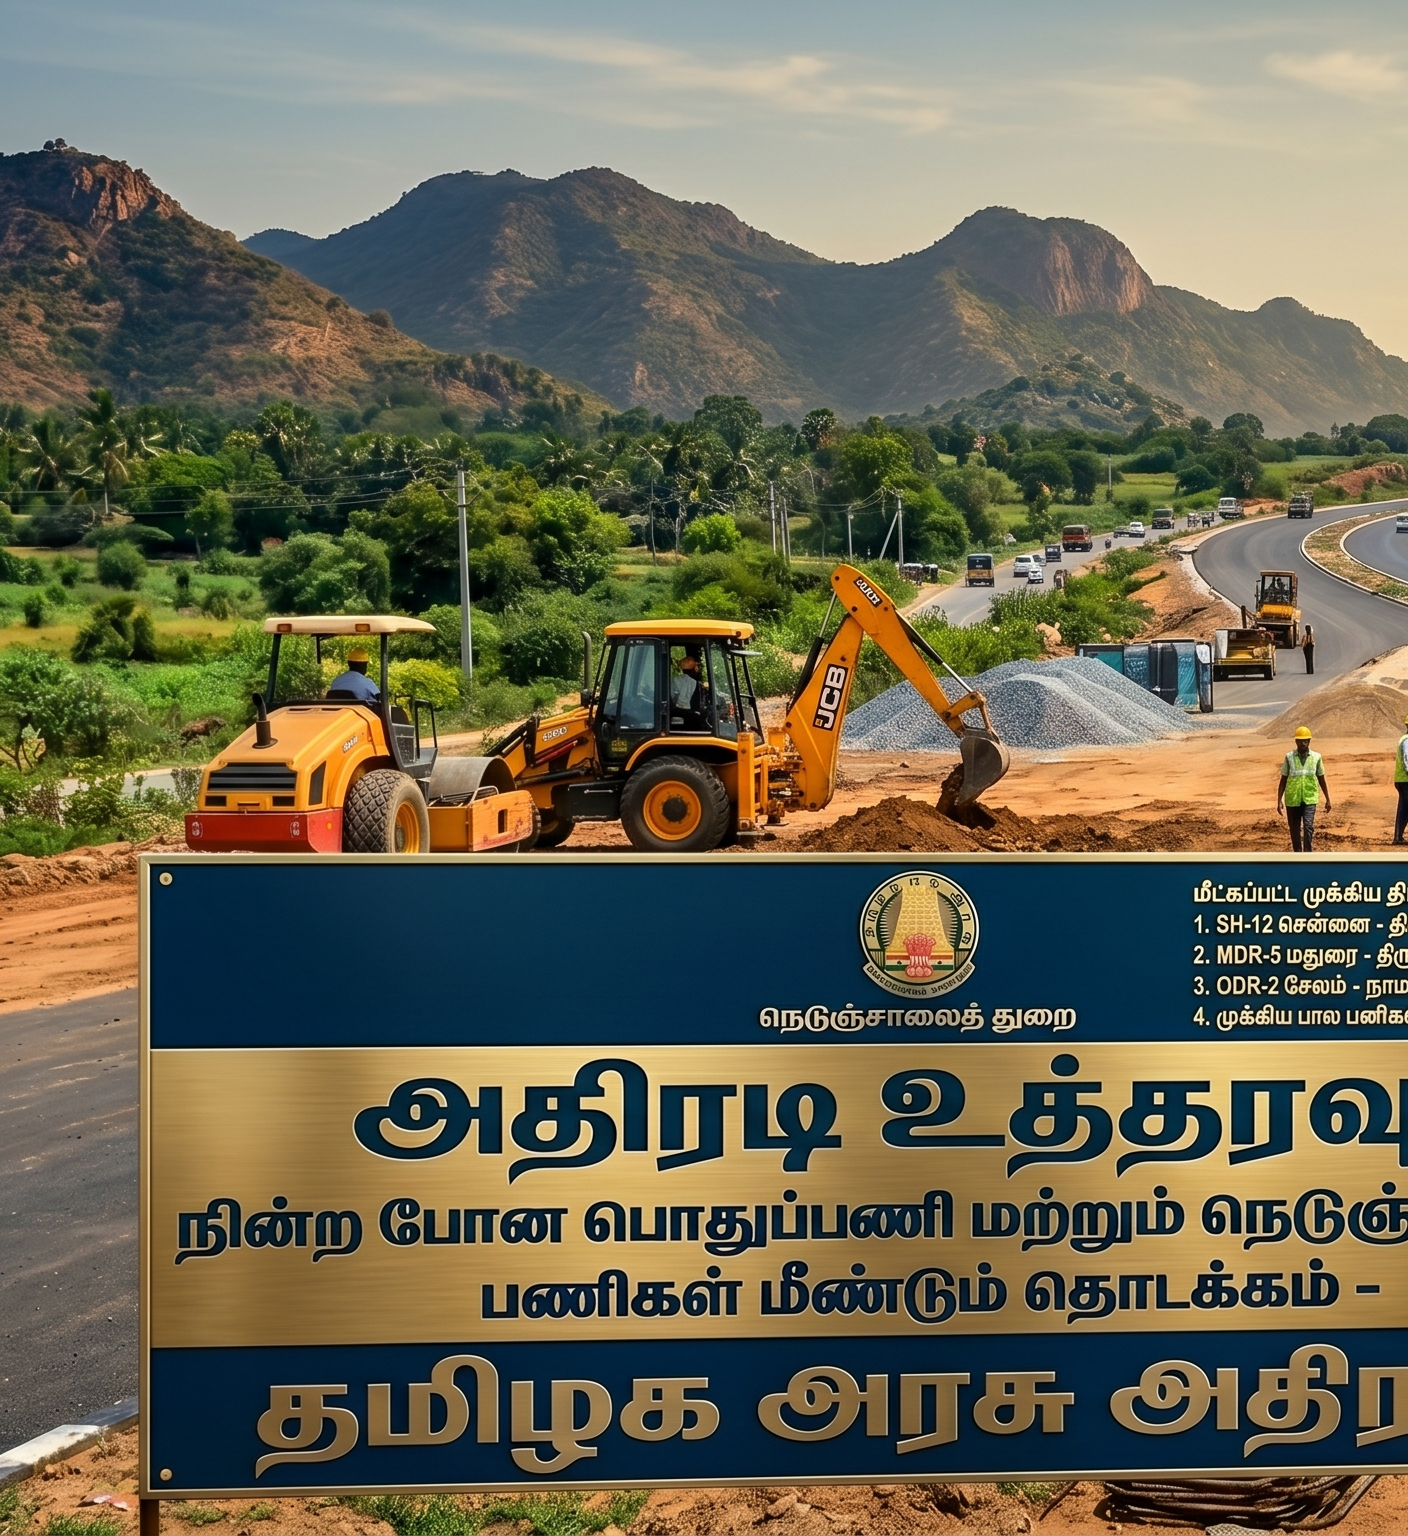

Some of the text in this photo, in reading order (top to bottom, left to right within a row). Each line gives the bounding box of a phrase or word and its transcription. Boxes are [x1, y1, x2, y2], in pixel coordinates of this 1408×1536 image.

[820, 665, 847, 730] JCB
[1194, 879, 1297, 903] மீட்கப்பட்ட
[1303, 881, 1381, 908] முக்கிய
[1194, 914, 1210, 933] 1.
[1216, 914, 1273, 934] SH-12
[1278, 912, 1371, 933] சென்னை
[1193, 945, 1210, 964] 2.
[1217, 945, 1281, 964] MDR-5
[1286, 948, 1359, 971] மதுரை
[1193, 976, 1210, 995] 3.
[1216, 976, 1279, 995] ODR-2
[1284, 974, 1347, 995] சேலம்
[759, 1003, 1077, 1034] நெடுஞ்சாலைத் துறை
[1193, 1006, 1210, 1026] 4.
[1216, 1004, 1292, 1031] முக்கிய
[1298, 1010, 1341, 1025] பால
[353, 1058, 842, 1186] அதிரடி
[174, 1196, 363, 1265] நின்ற
[379, 1197, 568, 1246] போன
[584, 1189, 953, 1256] பொதுப்பணி
[971, 1185, 1185, 1252] மற்றும்
[480, 1266, 743, 1321] பணிகள்
[761, 1260, 1008, 1324] மீண்டும்
[1023, 1257, 1341, 1326] தொடக்கம்
[255, 1353, 721, 1480] தமிழக
[757, 1365, 1075, 1455] அரசு
